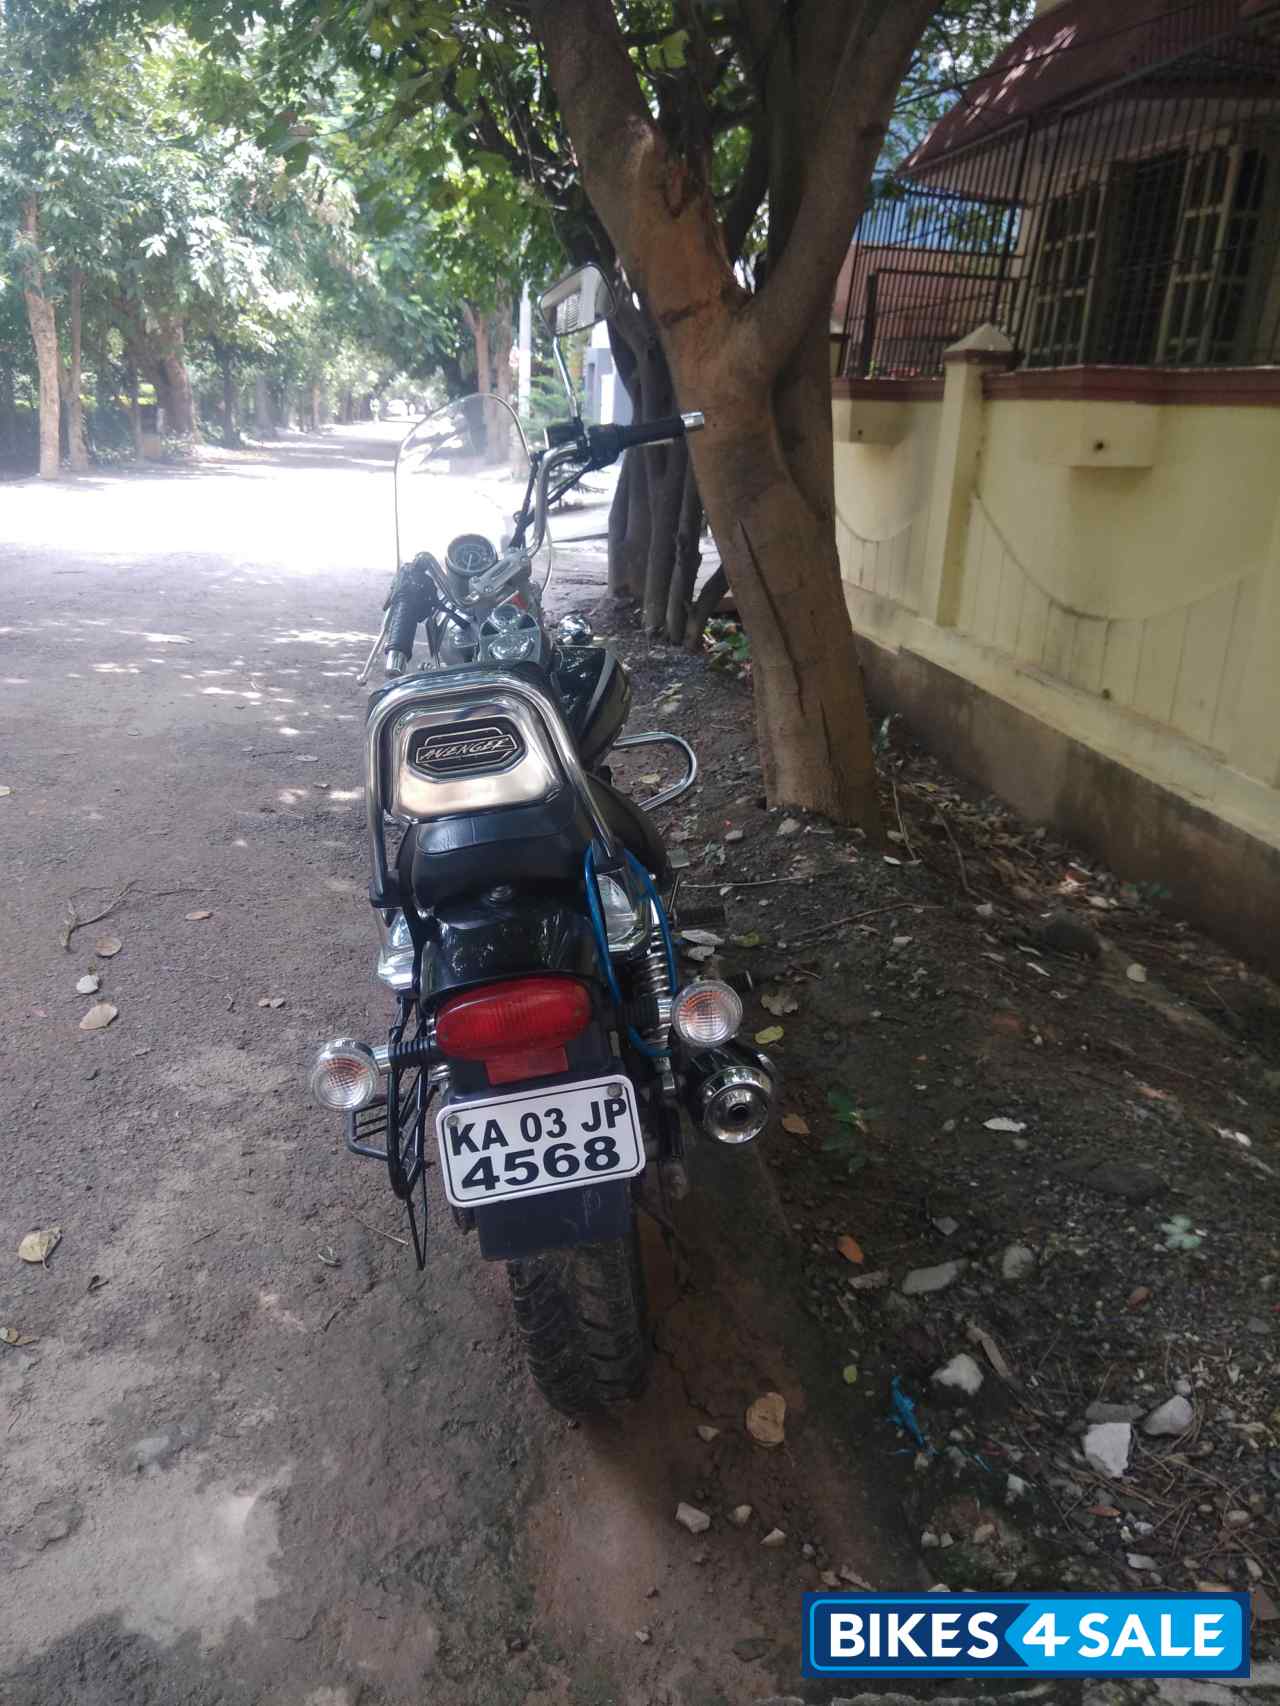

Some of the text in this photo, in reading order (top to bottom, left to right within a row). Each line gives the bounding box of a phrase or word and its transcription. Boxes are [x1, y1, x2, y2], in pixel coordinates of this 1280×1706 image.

[419, 737, 510, 761] AVENGER
[449, 1097, 627, 1156] KA 03 JP
[461, 1136, 621, 1191] 4568
